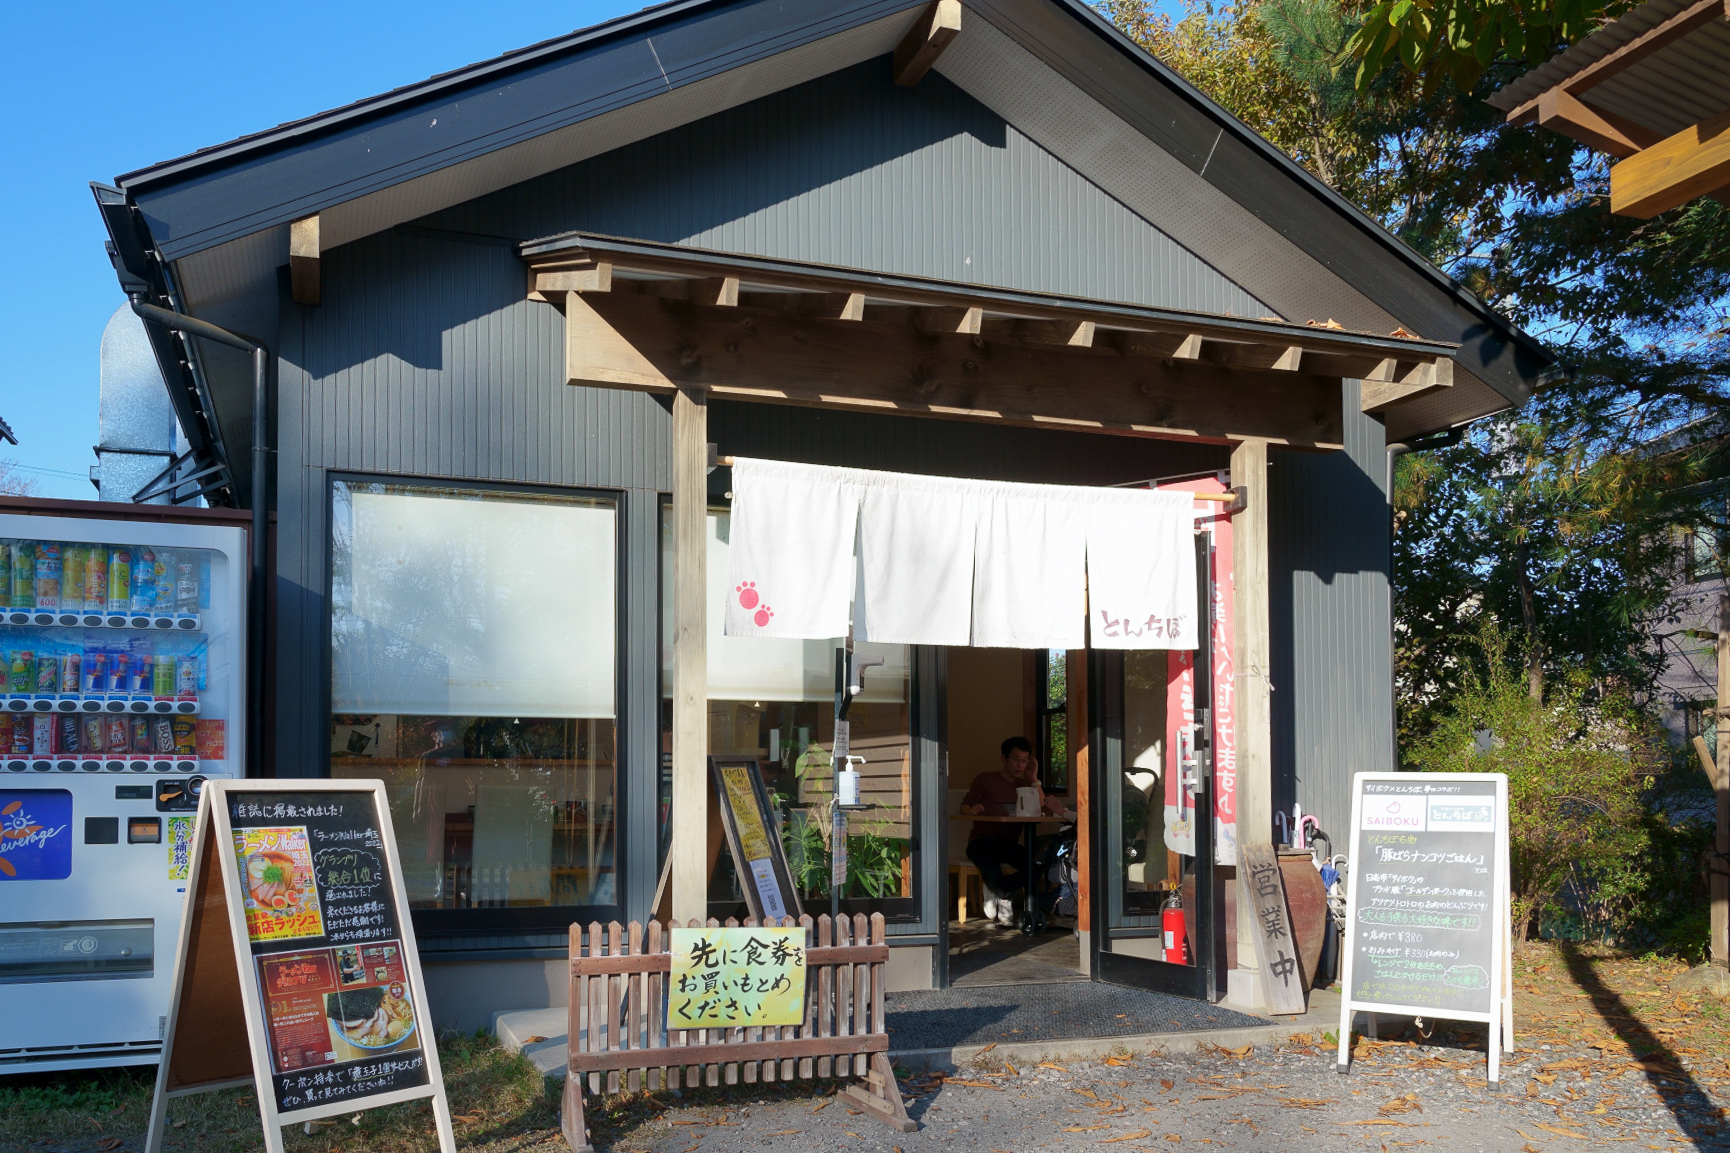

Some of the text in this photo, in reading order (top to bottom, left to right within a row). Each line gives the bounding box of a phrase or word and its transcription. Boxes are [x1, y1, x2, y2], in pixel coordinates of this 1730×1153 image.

[40, 598, 56, 607] 600
[1101, 609, 1188, 639] とんちぼ
[64, 718, 80, 752] BLACK
[159, 723, 173, 752] BOSS
[1366, 816, 1419, 826] SAIBOKU
[1432, 808, 1474, 821] とんちぼ
[0, 824, 67, 853] everage
[319, 853, 358, 868] グランプリ
[1252, 862, 1296, 989] 営業中
[689, 936, 803, 970] 先に食券を
[678, 971, 791, 996] お買いもとめ
[677, 997, 768, 1021] ください。
